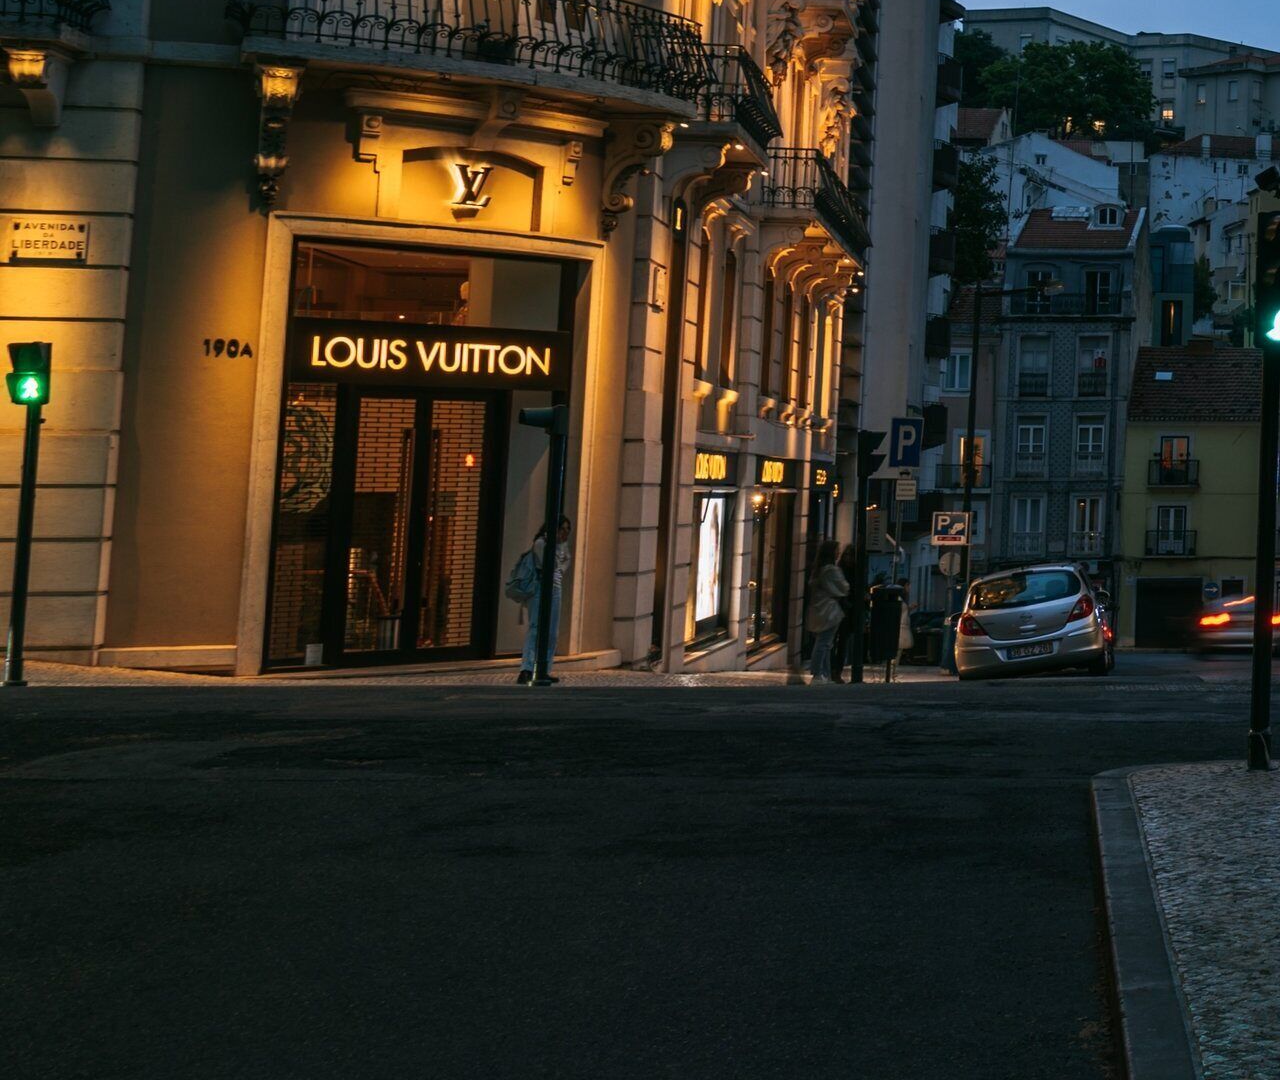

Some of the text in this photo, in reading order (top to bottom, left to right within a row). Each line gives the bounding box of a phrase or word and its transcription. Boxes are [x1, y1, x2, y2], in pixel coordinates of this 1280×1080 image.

[24, 222, 76, 231] AVENIDA
[11, 239, 85, 251] LIBERDADE
[203, 338, 253, 359] 190A
[311, 335, 551, 376] LOUIS VUITTON
[897, 425, 917, 461] P
[936, 515, 951, 531] P
